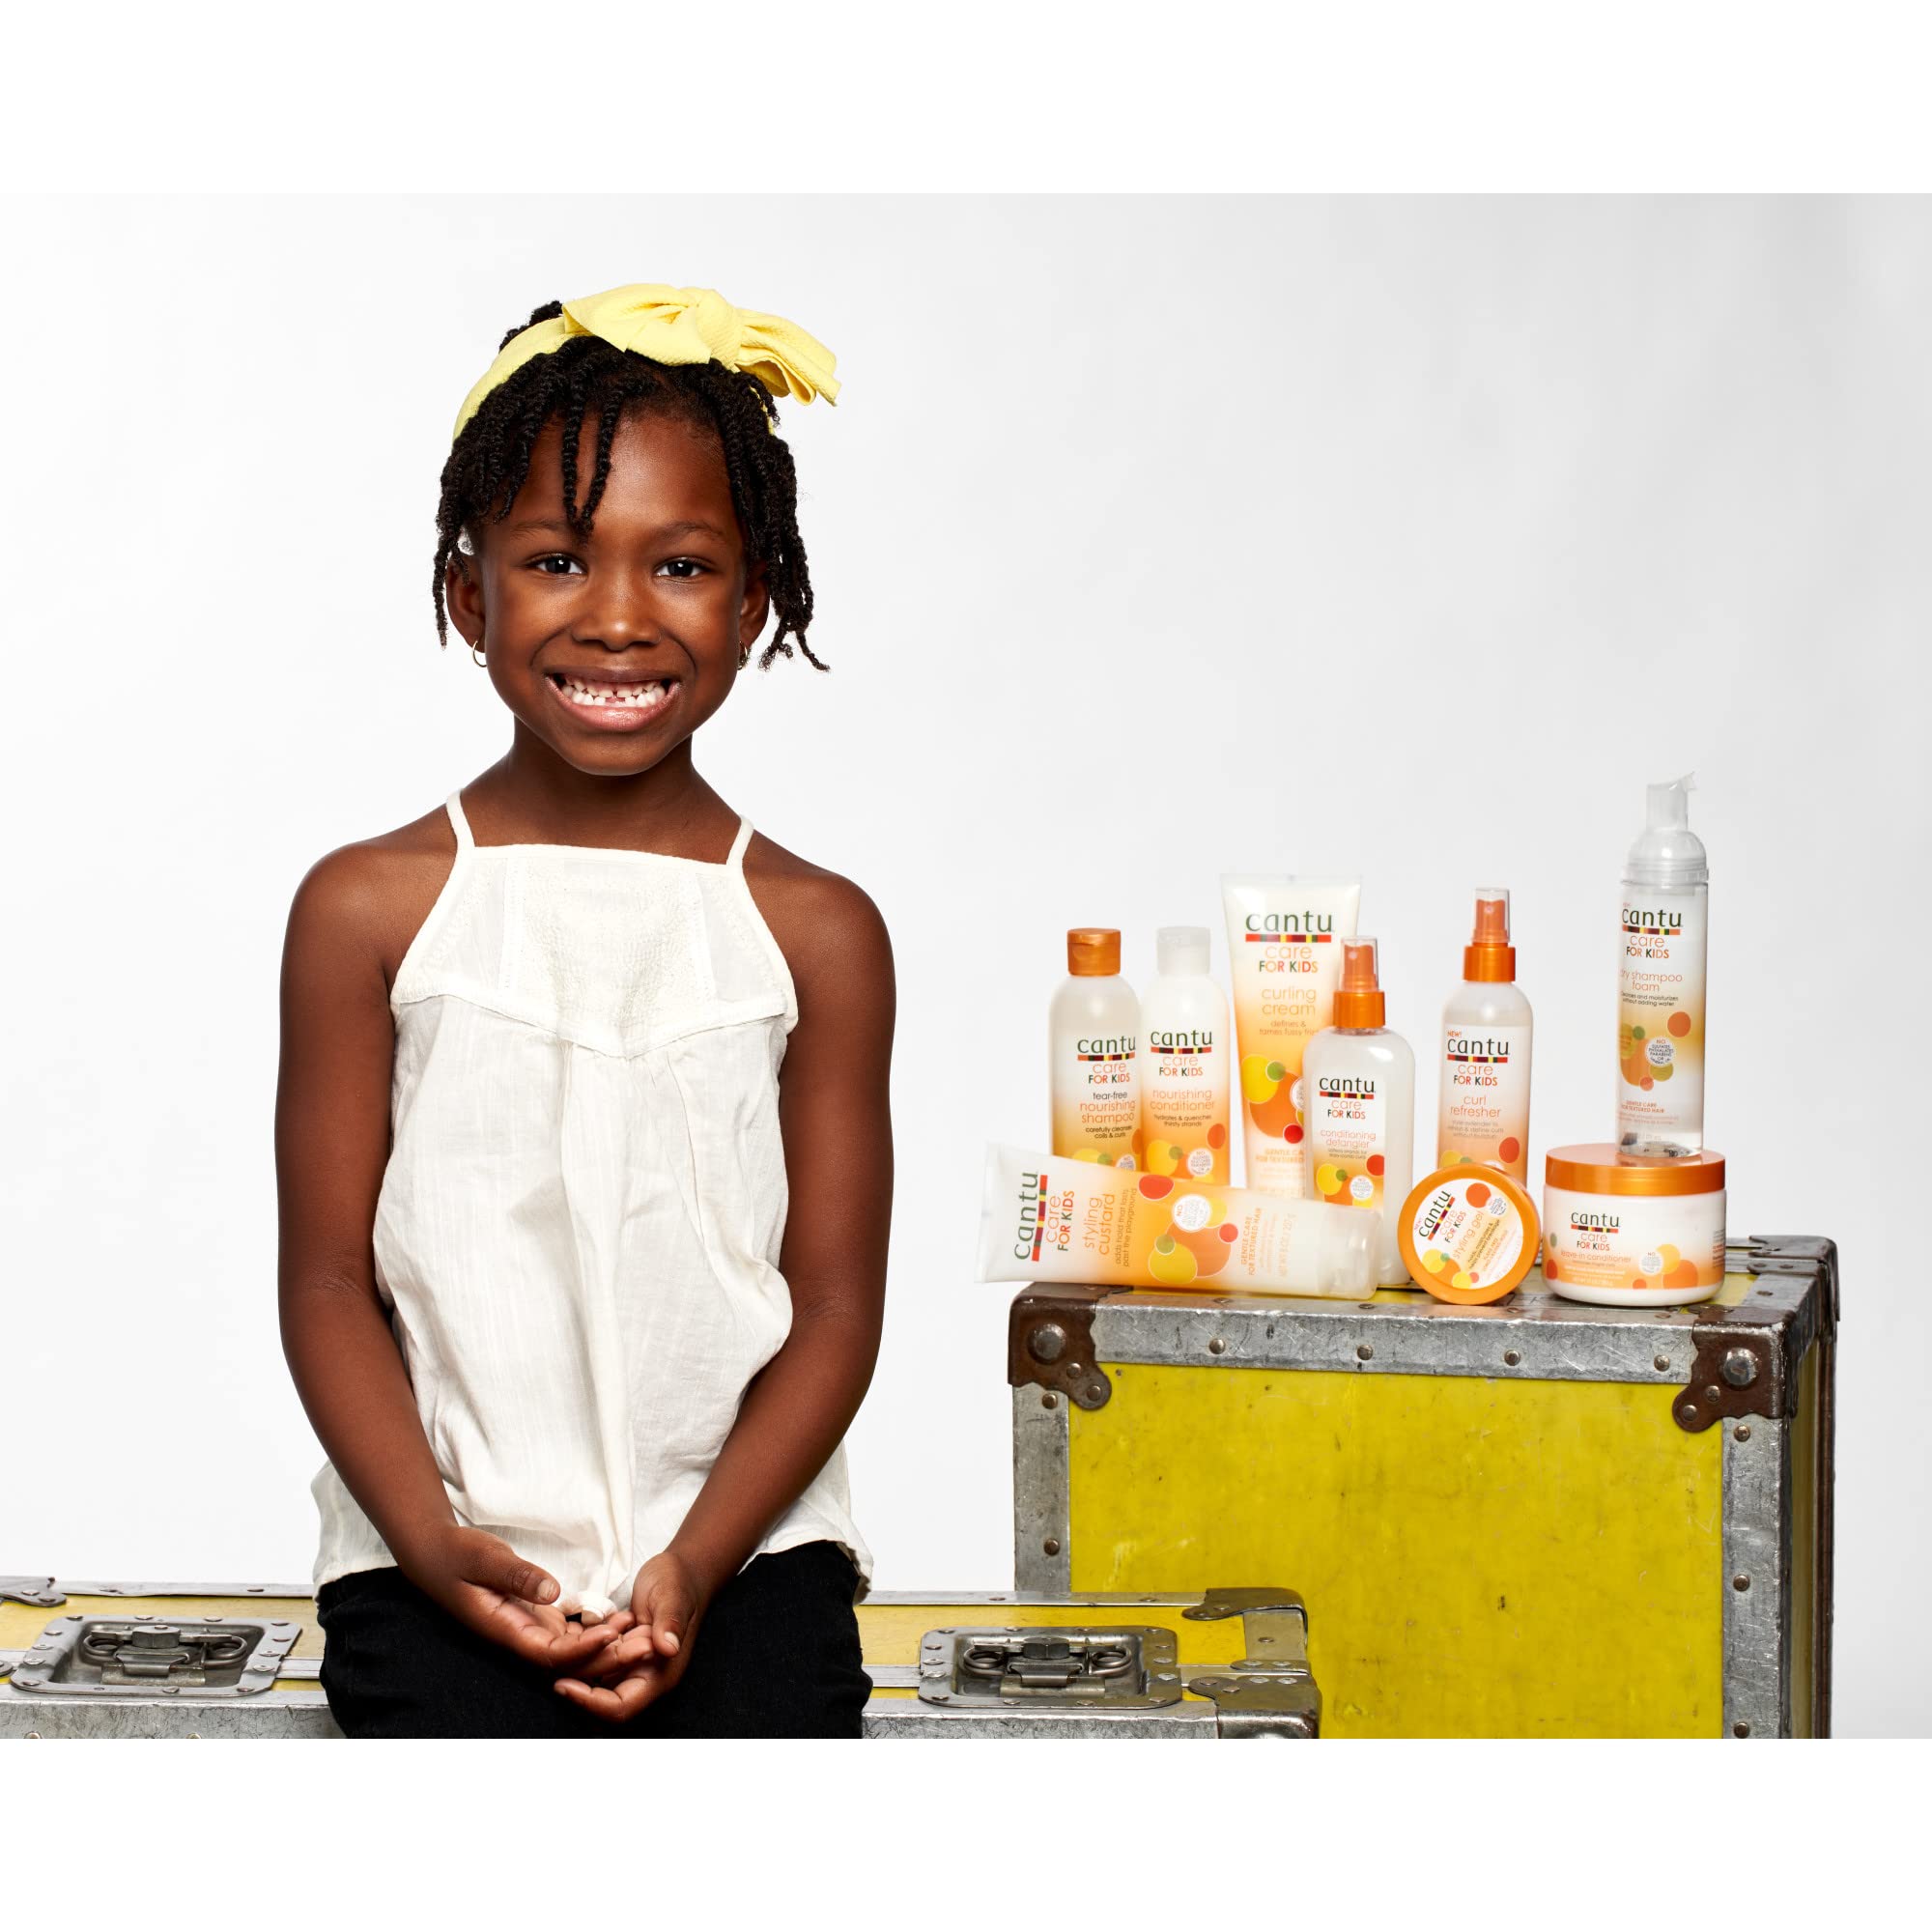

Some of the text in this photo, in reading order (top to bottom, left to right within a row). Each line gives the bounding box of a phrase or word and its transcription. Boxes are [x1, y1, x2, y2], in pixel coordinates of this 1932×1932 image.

[1245, 910, 1333, 932] cantu
[1622, 908, 1682, 927] cantu
[1630, 935, 1664, 948] care
[1264, 946, 1313, 959] care
[1626, 947, 1669, 959] FOR KIDS
[1259, 960, 1319, 973] FOR KIDS
[1631, 969, 1683, 983] shampoo
[1632, 980, 1660, 992] foam
[1261, 986, 1318, 1004] curling
[1262, 1004, 1316, 1016] cream
[1077, 1036, 1136, 1054] cantu
[1151, 1030, 1213, 1047] cantu
[1447, 1038, 1509, 1056] cantu
[1162, 1056, 1199, 1066] care
[1093, 1063, 1126, 1074] care
[1159, 1066, 1204, 1077] FOR KIDS
[1458, 1064, 1493, 1076] care
[1089, 1073, 1130, 1084] FOR KIDS
[1454, 1075, 1498, 1087] FOR KIDS
[1319, 1077, 1375, 1094] cantu
[1093, 1091, 1128, 1101] tear-free
[1152, 1089, 1212, 1102] nourishing
[1463, 1094, 1487, 1106] curl
[1080, 1100, 1136, 1113] nourishing
[1150, 1099, 1214, 1112] conditioner
[1331, 1099, 1362, 1111] care
[1082, 1112, 1135, 1124] shampoo
[1327, 1109, 1366, 1120] FOR KIDS
[1450, 1105, 1501, 1119] refresher
[1321, 1128, 1377, 1142] conditioning
[1325, 1138, 1370, 1150] detangler
[1014, 1172, 1038, 1261] cantu
[1046, 1195, 1061, 1243] care
[1419, 1190, 1451, 1237] cantu
[1571, 1211, 1620, 1228] cantu
[1057, 1190, 1075, 1252] FOR KIDS
[1083, 1197, 1102, 1249] styling
[1098, 1193, 1116, 1256] custard
[1439, 1209, 1458, 1236] care
[1444, 1210, 1467, 1243] FOR KIDS
[1453, 1209, 1485, 1260] styling gel
[1580, 1232, 1607, 1243] care
[1577, 1240, 1610, 1251] FOR KIDS
[1560, 1249, 1586, 1260] leave-in
[1587, 1250, 1632, 1264] conditioner
